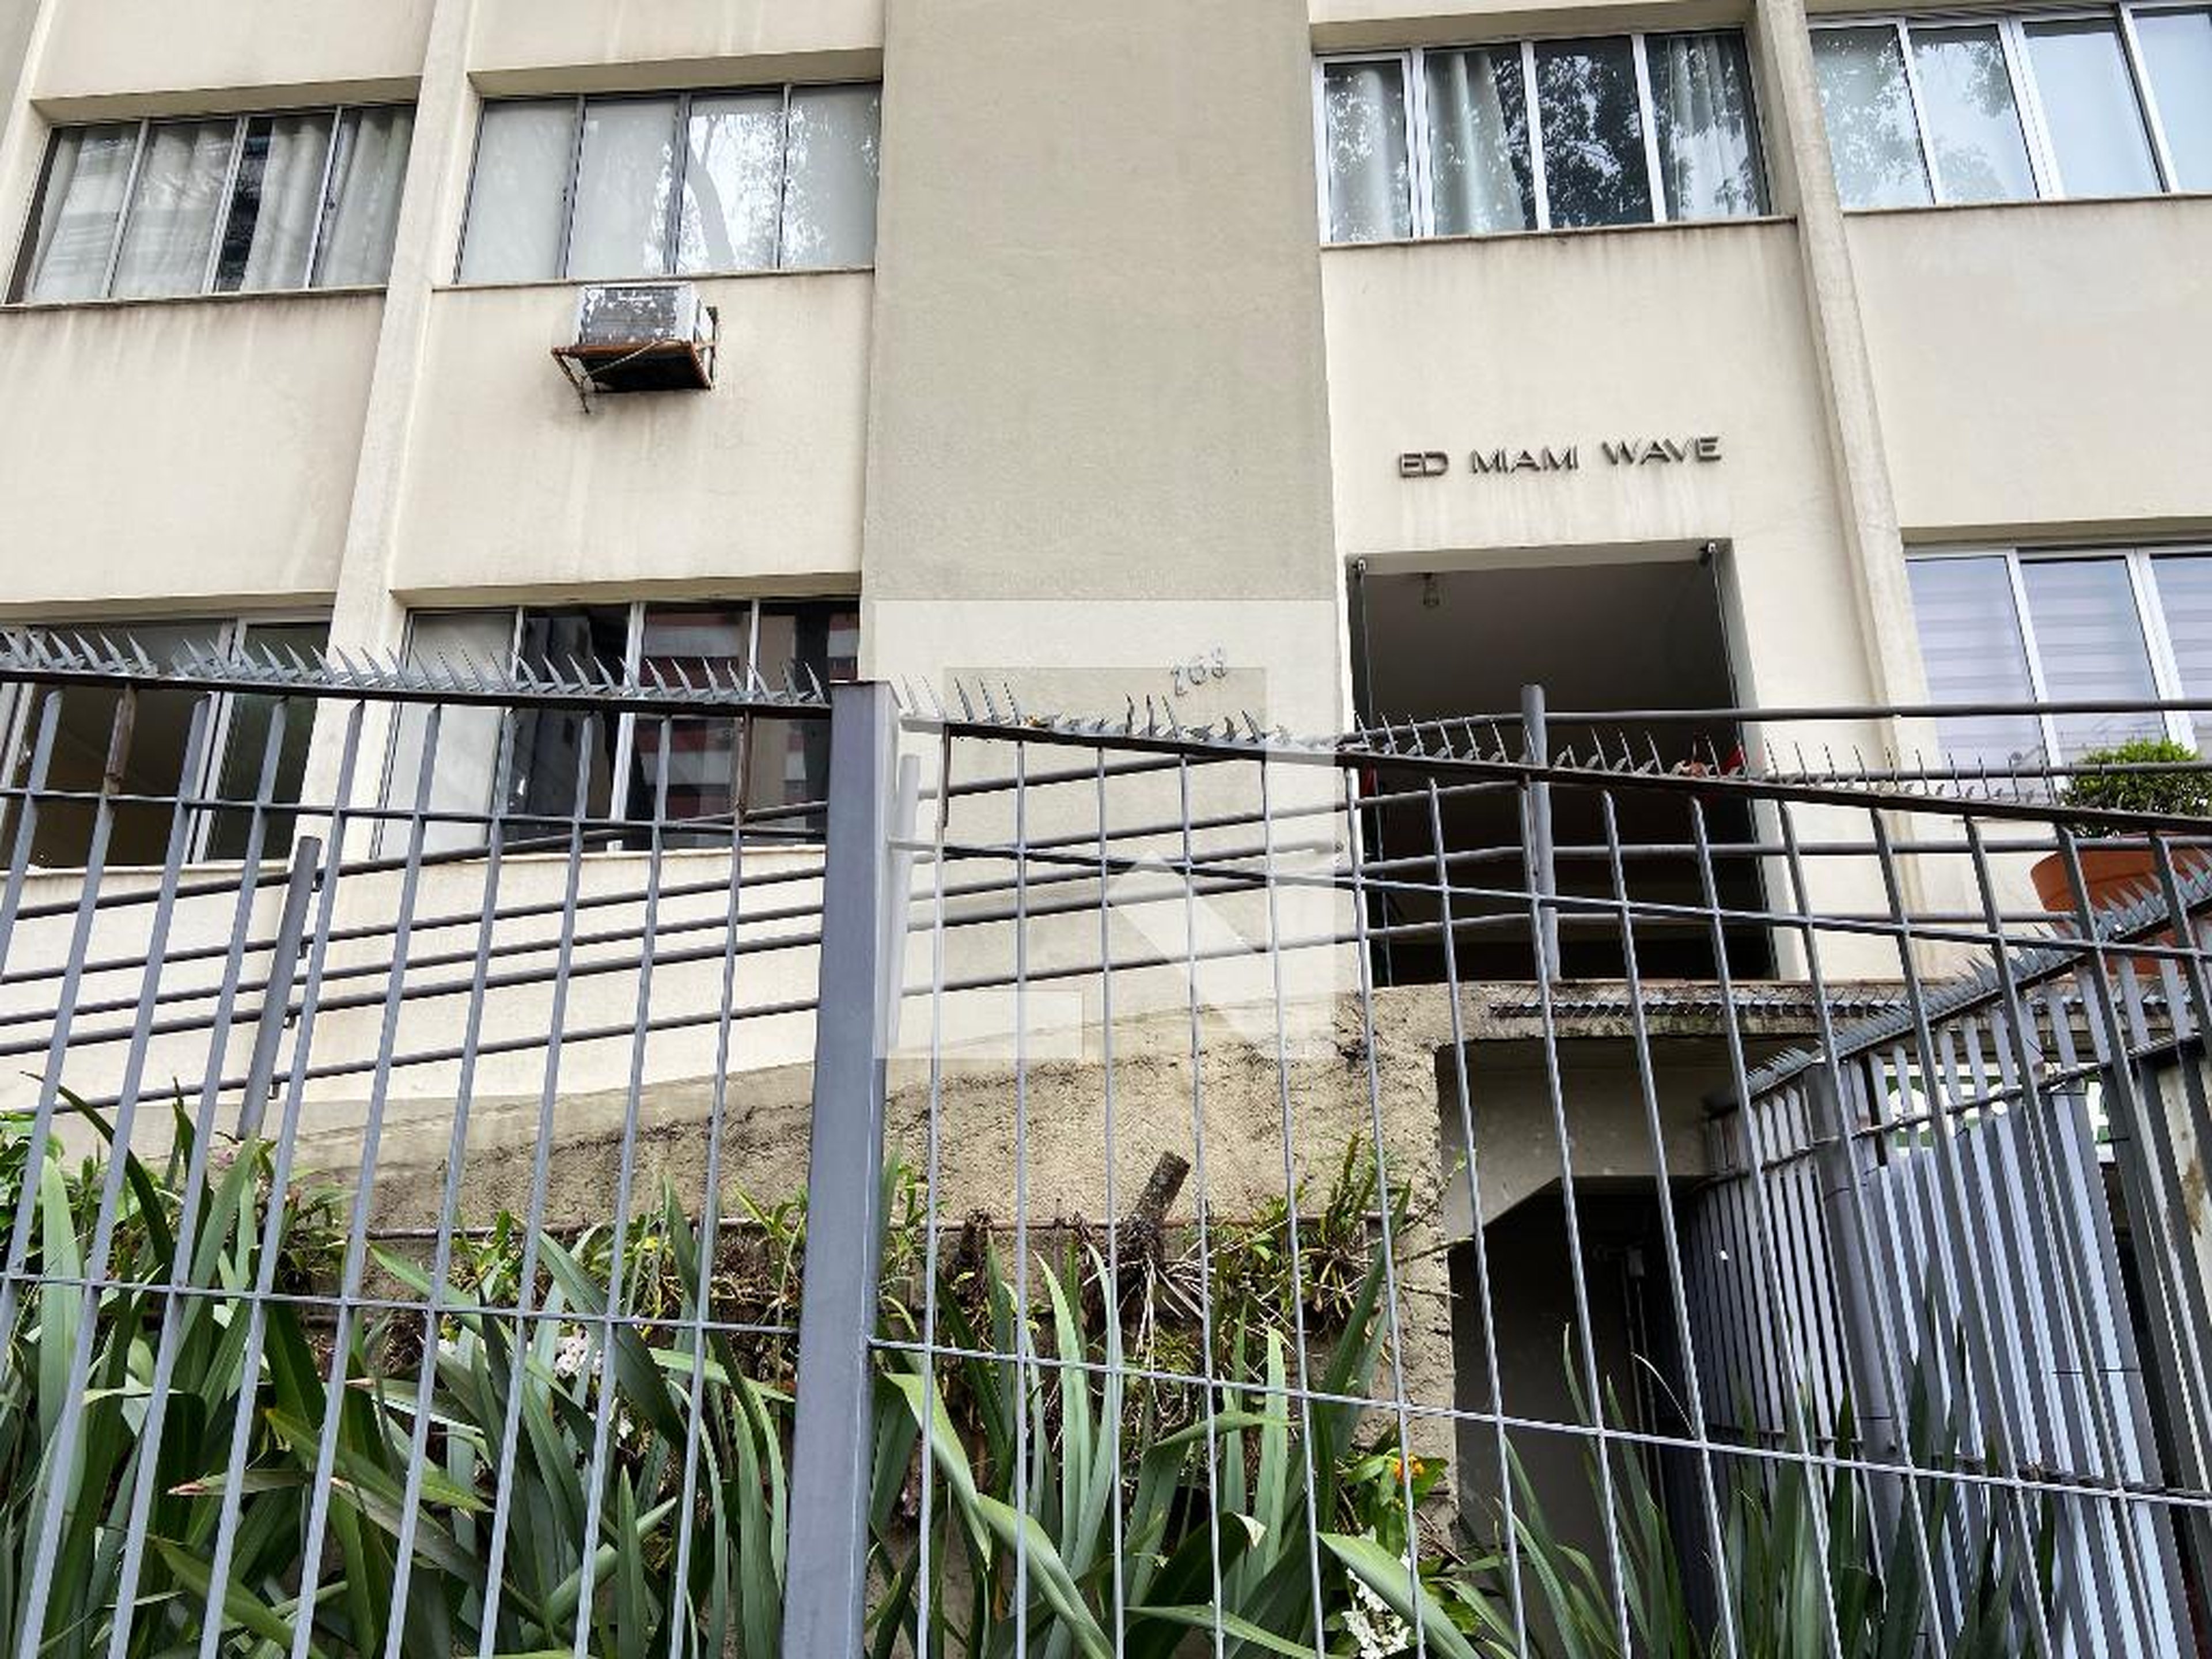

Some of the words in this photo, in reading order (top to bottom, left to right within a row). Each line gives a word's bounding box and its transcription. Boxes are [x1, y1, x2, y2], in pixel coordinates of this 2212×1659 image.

[1399, 450, 1449, 478] ED
[1469, 445, 1580, 474] MIAMI
[1601, 437, 1722, 465] WAVE
